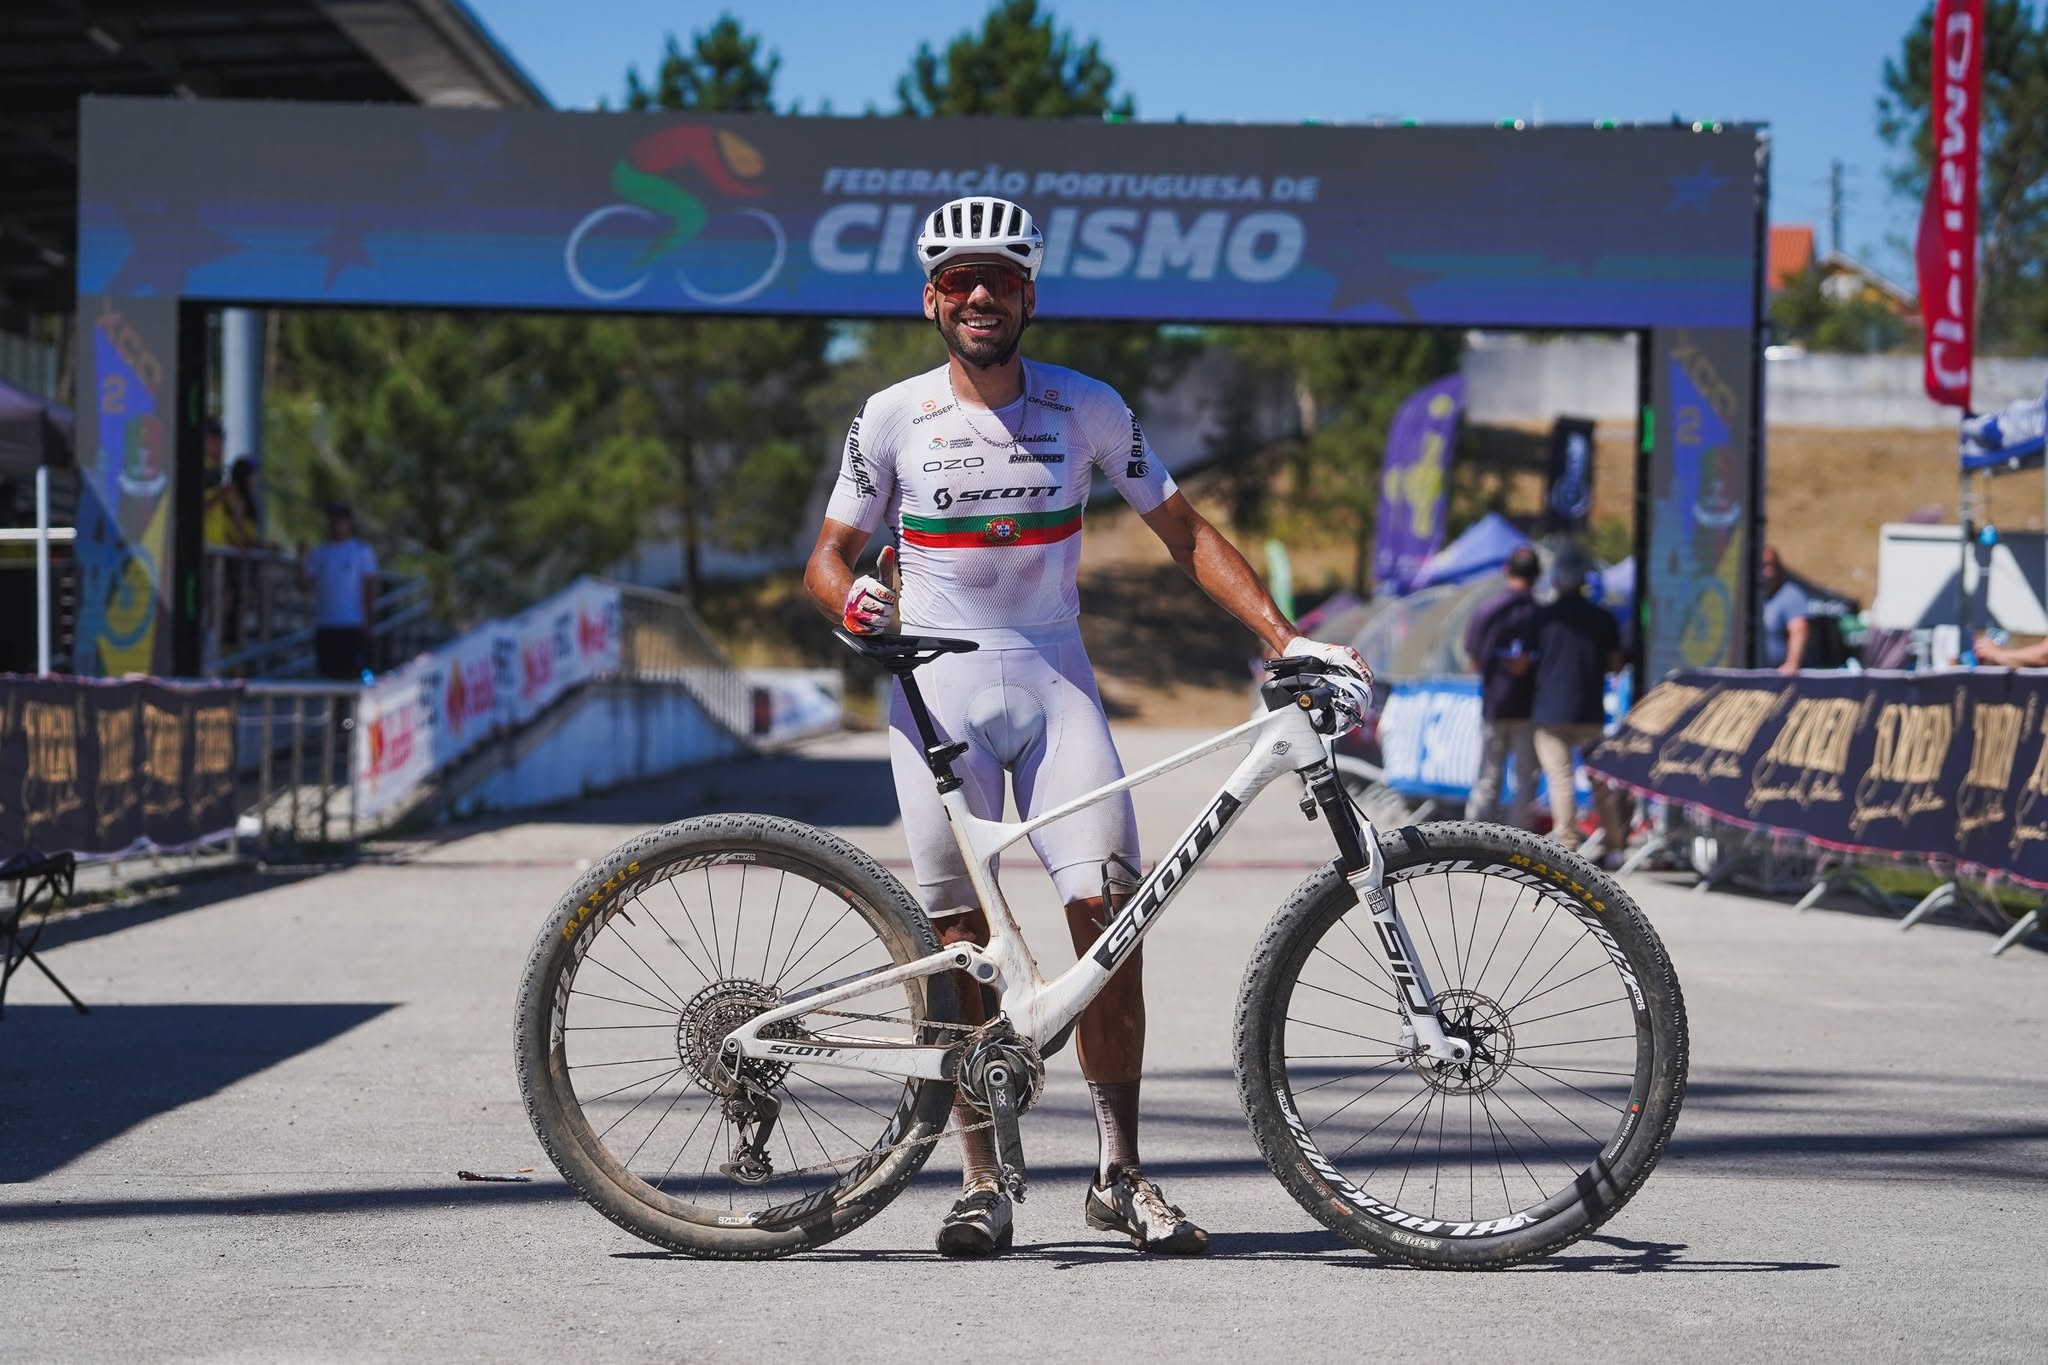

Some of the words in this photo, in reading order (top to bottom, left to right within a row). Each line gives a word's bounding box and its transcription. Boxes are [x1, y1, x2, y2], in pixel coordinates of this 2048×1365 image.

[821, 164, 1028, 196] FEDERAÇÃO
[1032, 171, 1262, 200] PORTUGUESA
[1270, 177, 1320, 201] DE
[809, 204, 1304, 283] CIISMO
[101, 375, 127, 414] 2
[1028, 396, 1071, 413] OFORSEP
[912, 404, 954, 425] OFORSEP
[1676, 408, 1701, 445] 2
[923, 457, 985, 473] OZO
[959, 486, 1062, 502] SCOTT
[1107, 799, 1224, 964] SCOTT
[1508, 853, 1607, 913] MAXXIS
[562, 861, 641, 942] MAXXIS
[767, 1045, 840, 1058] SCOTT
[1392, 1231, 1442, 1249] ASPEN
